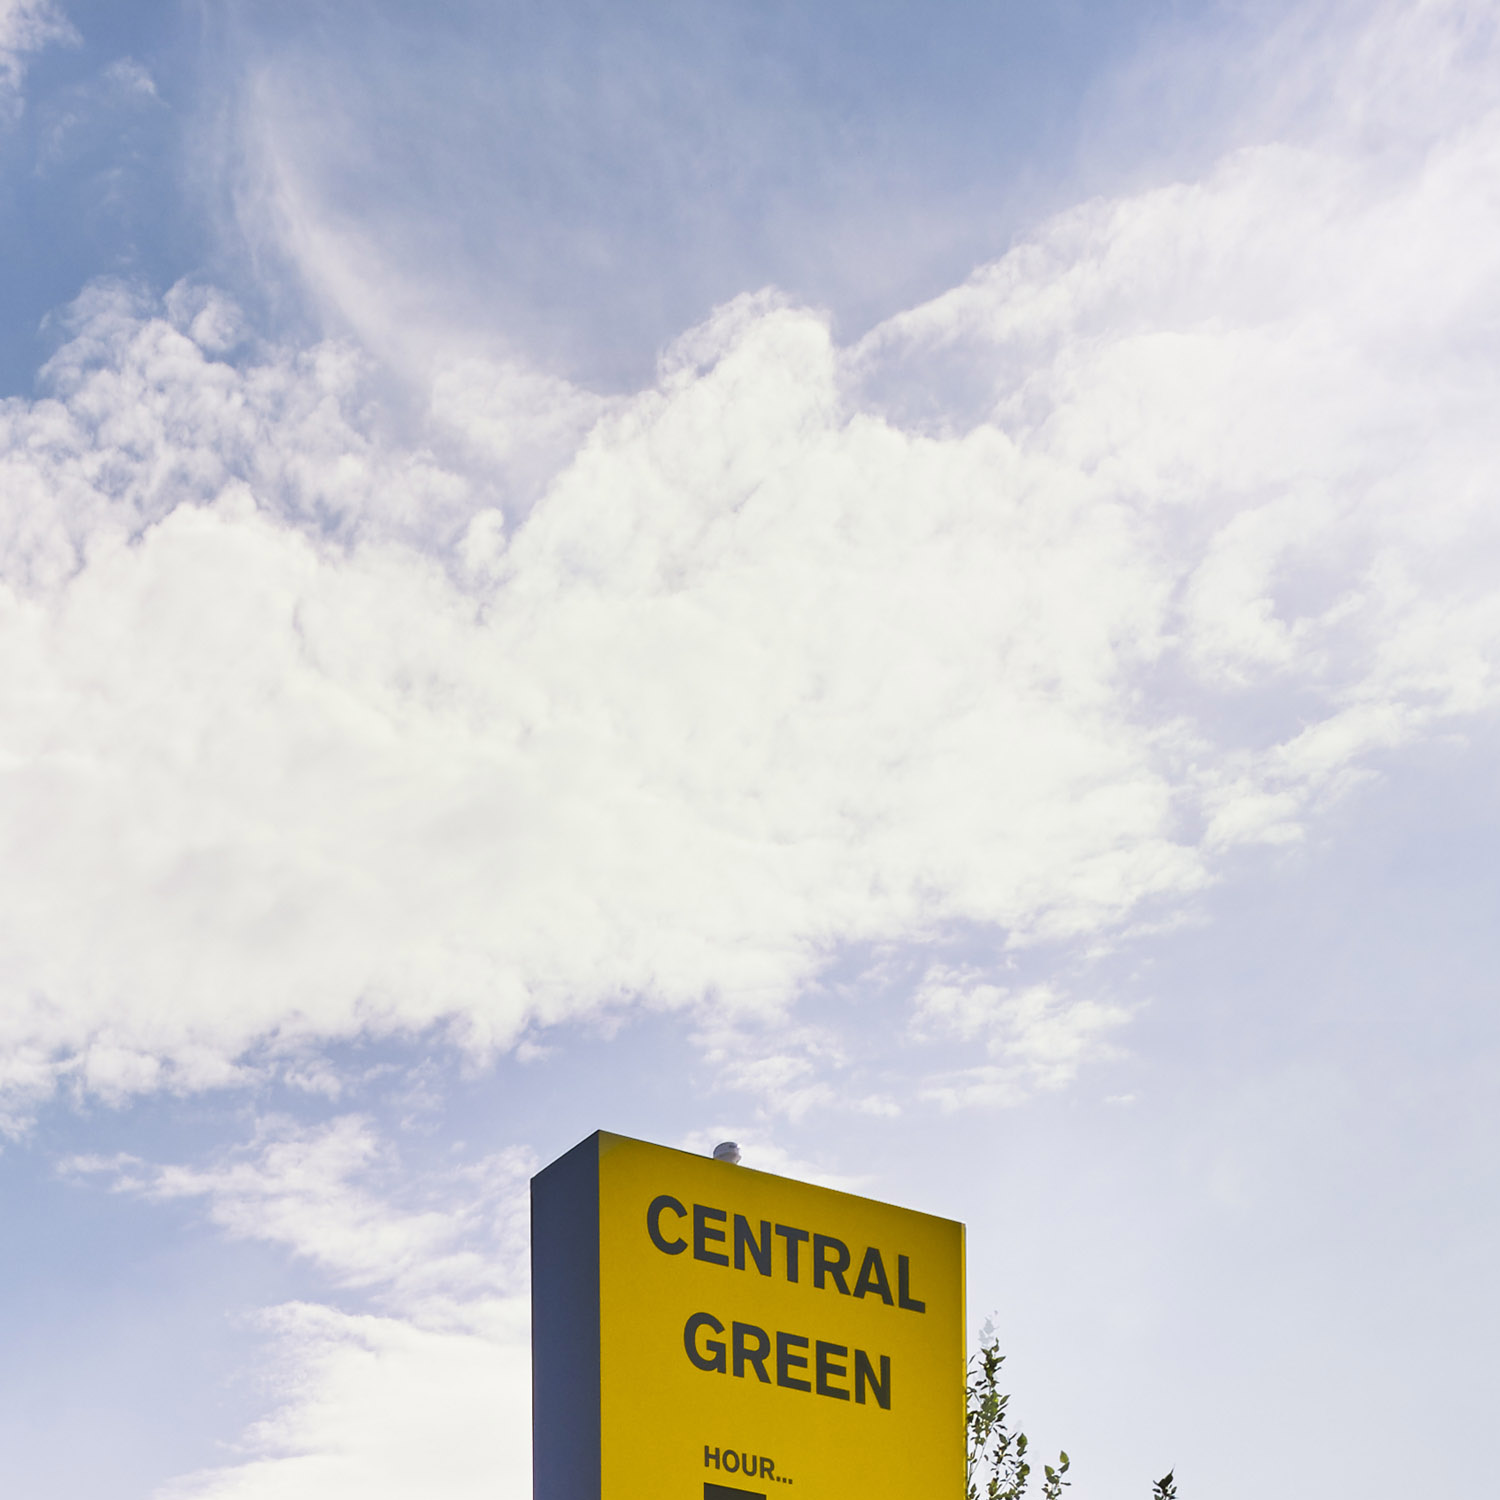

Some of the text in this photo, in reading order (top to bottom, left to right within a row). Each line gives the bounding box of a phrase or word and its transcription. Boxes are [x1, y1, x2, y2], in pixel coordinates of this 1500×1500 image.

[646, 1194, 926, 1314] CENTRAL
[683, 1311, 891, 1411] GREEN
[704, 1445, 793, 1485] HOUR...
